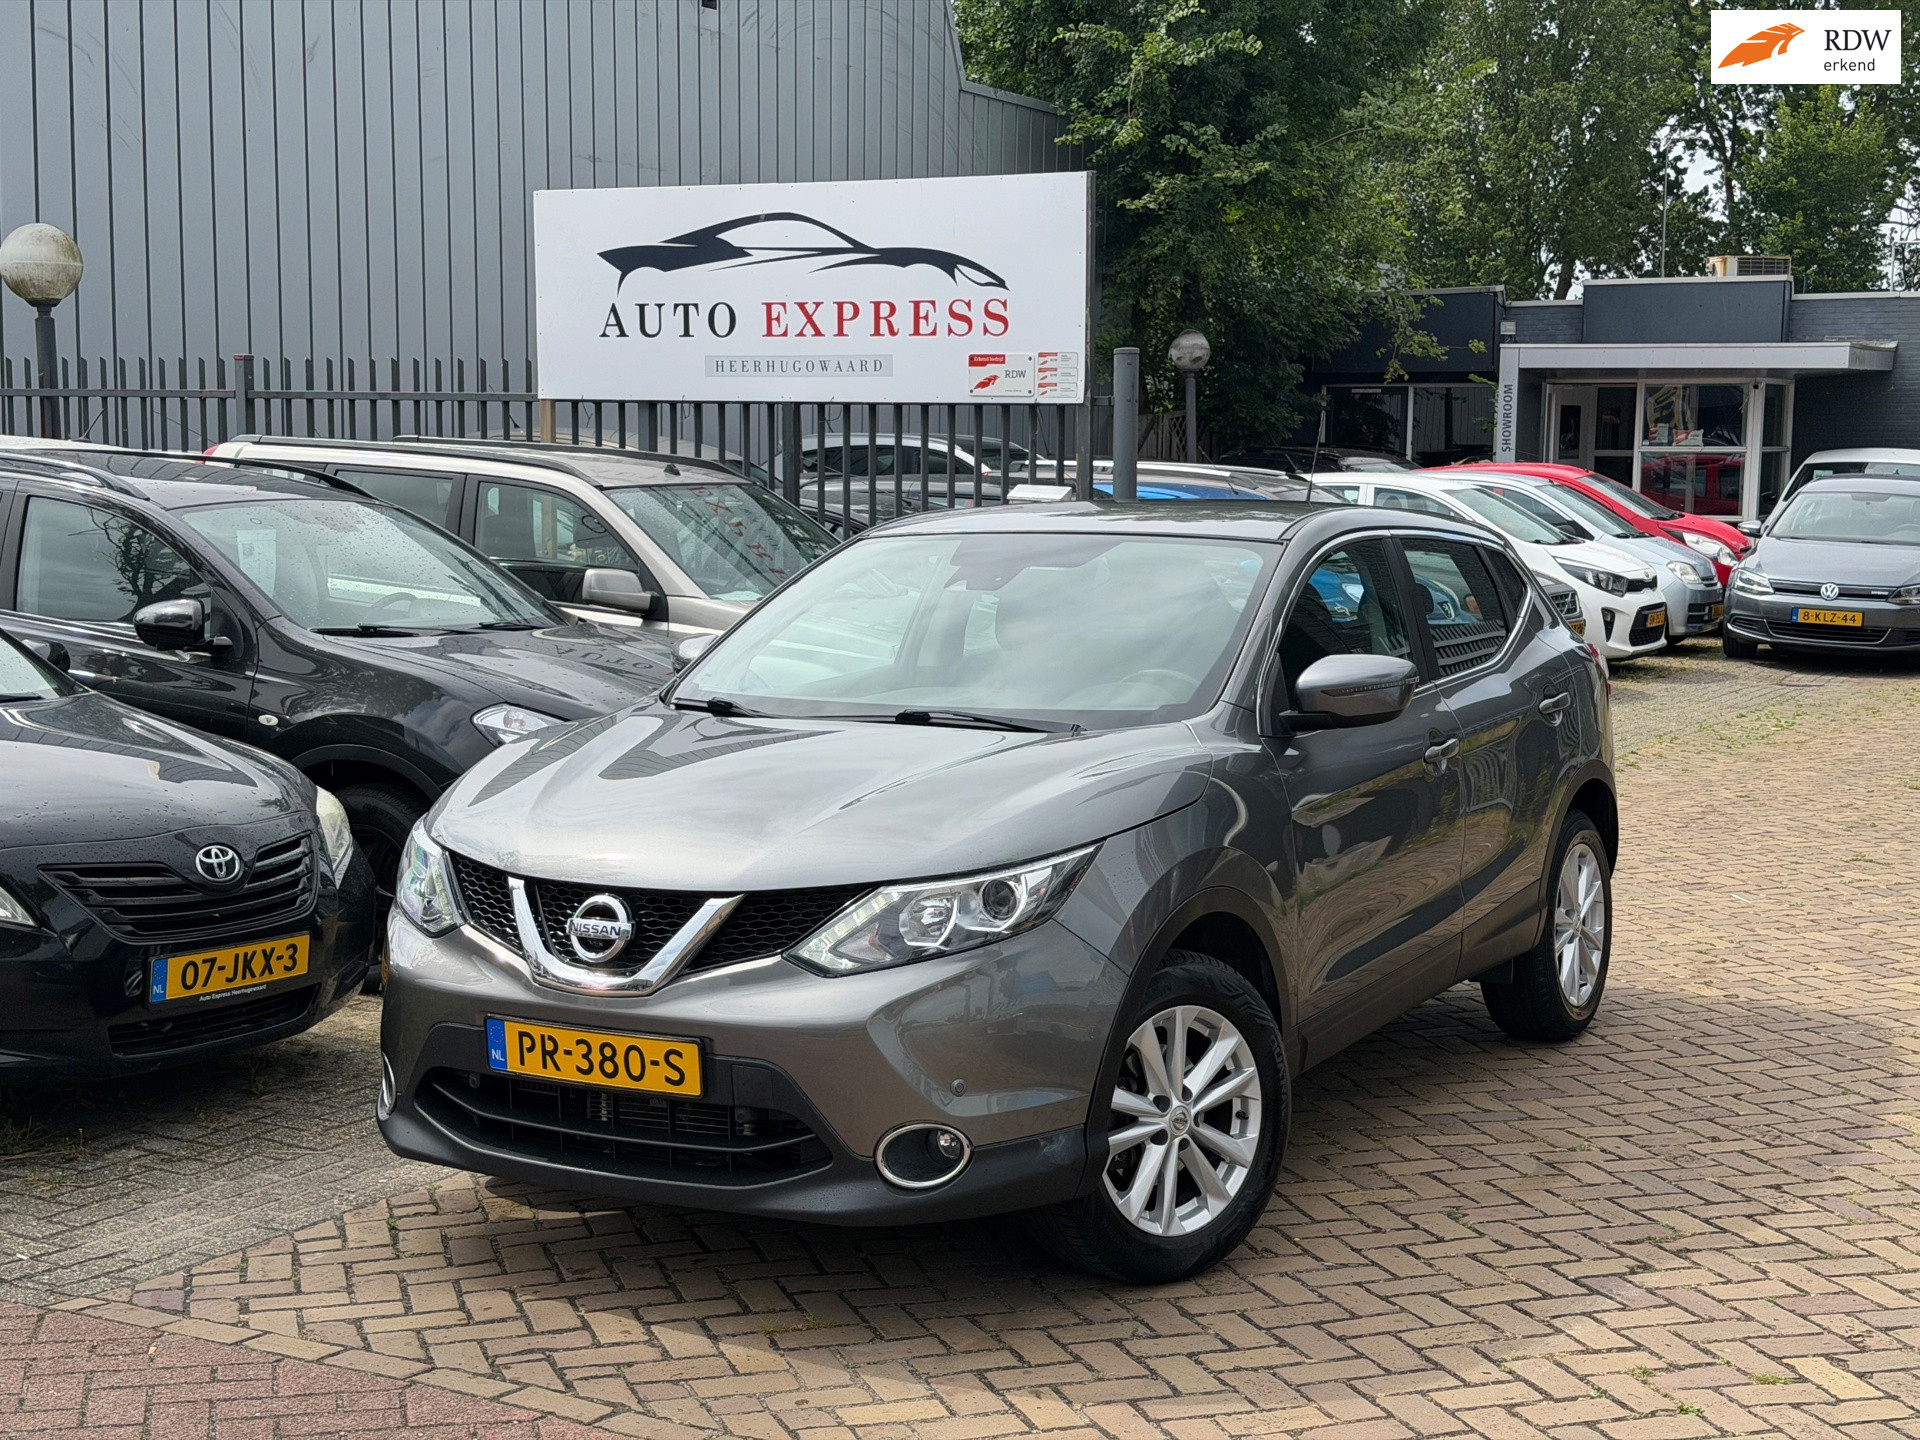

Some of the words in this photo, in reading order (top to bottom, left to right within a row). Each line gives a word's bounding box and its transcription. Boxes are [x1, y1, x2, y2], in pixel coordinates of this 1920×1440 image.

[599, 301, 737, 338] AUTO
[761, 298, 1010, 338] EXPRESS
[715, 358, 883, 374] HEERHUGOWAARD
[1004, 369, 1027, 379] RDW
[1501, 384, 1513, 453] SHOWROOM
[1802, 611, 1857, 625] 8-KLZ-44
[569, 920, 622, 937] NISSAN
[180, 943, 299, 991] 07-JKX-3
[152, 984, 165, 995] NL
[199, 994, 212, 1002] Auto
[212, 991, 231, 999] Express
[231, 984, 267, 996] Heerhugowaard
[491, 1048, 505, 1062] NL
[517, 1030, 686, 1087] PR-380-S
